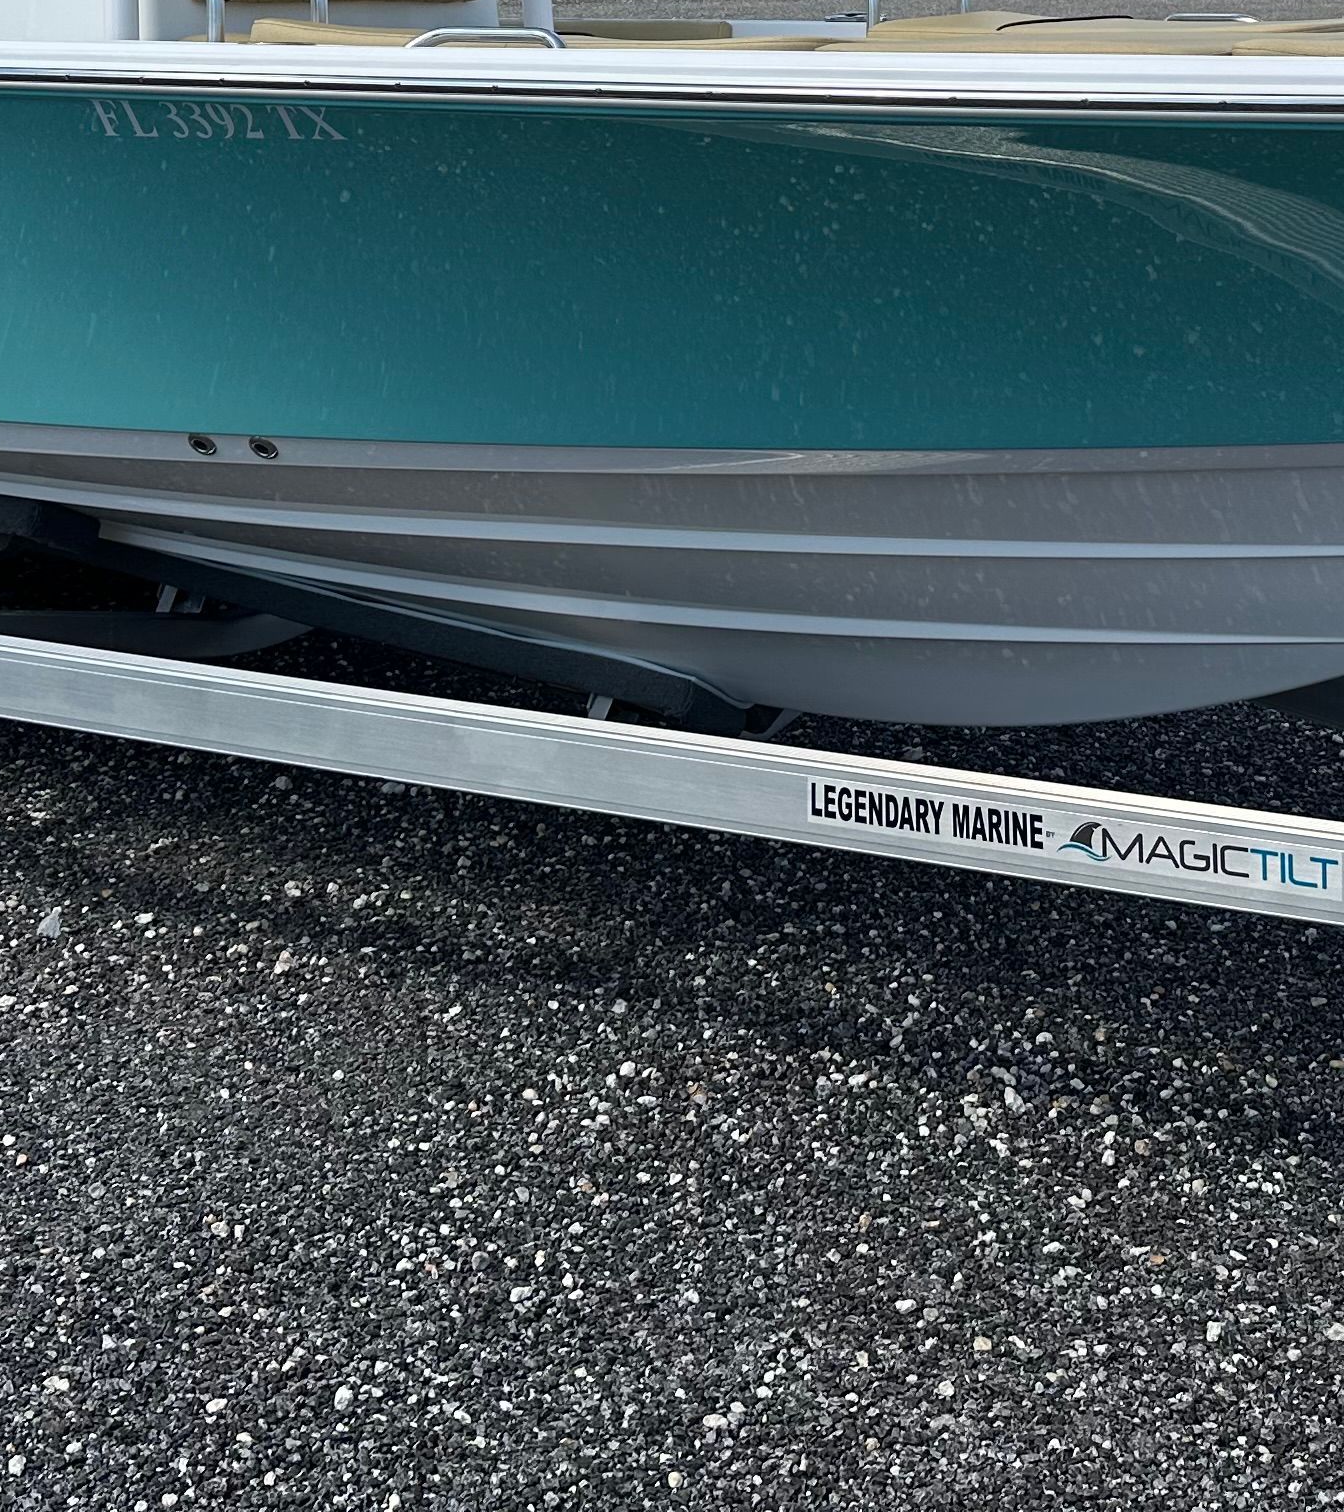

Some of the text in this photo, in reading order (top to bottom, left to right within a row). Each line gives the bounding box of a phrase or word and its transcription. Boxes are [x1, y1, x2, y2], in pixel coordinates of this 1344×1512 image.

[90, 98, 348, 139] FL 3392 TX
[810, 782, 945, 835] LEGENDARY
[953, 803, 1044, 850] MARINE
[1101, 826, 1339, 890] MAGICTILT
